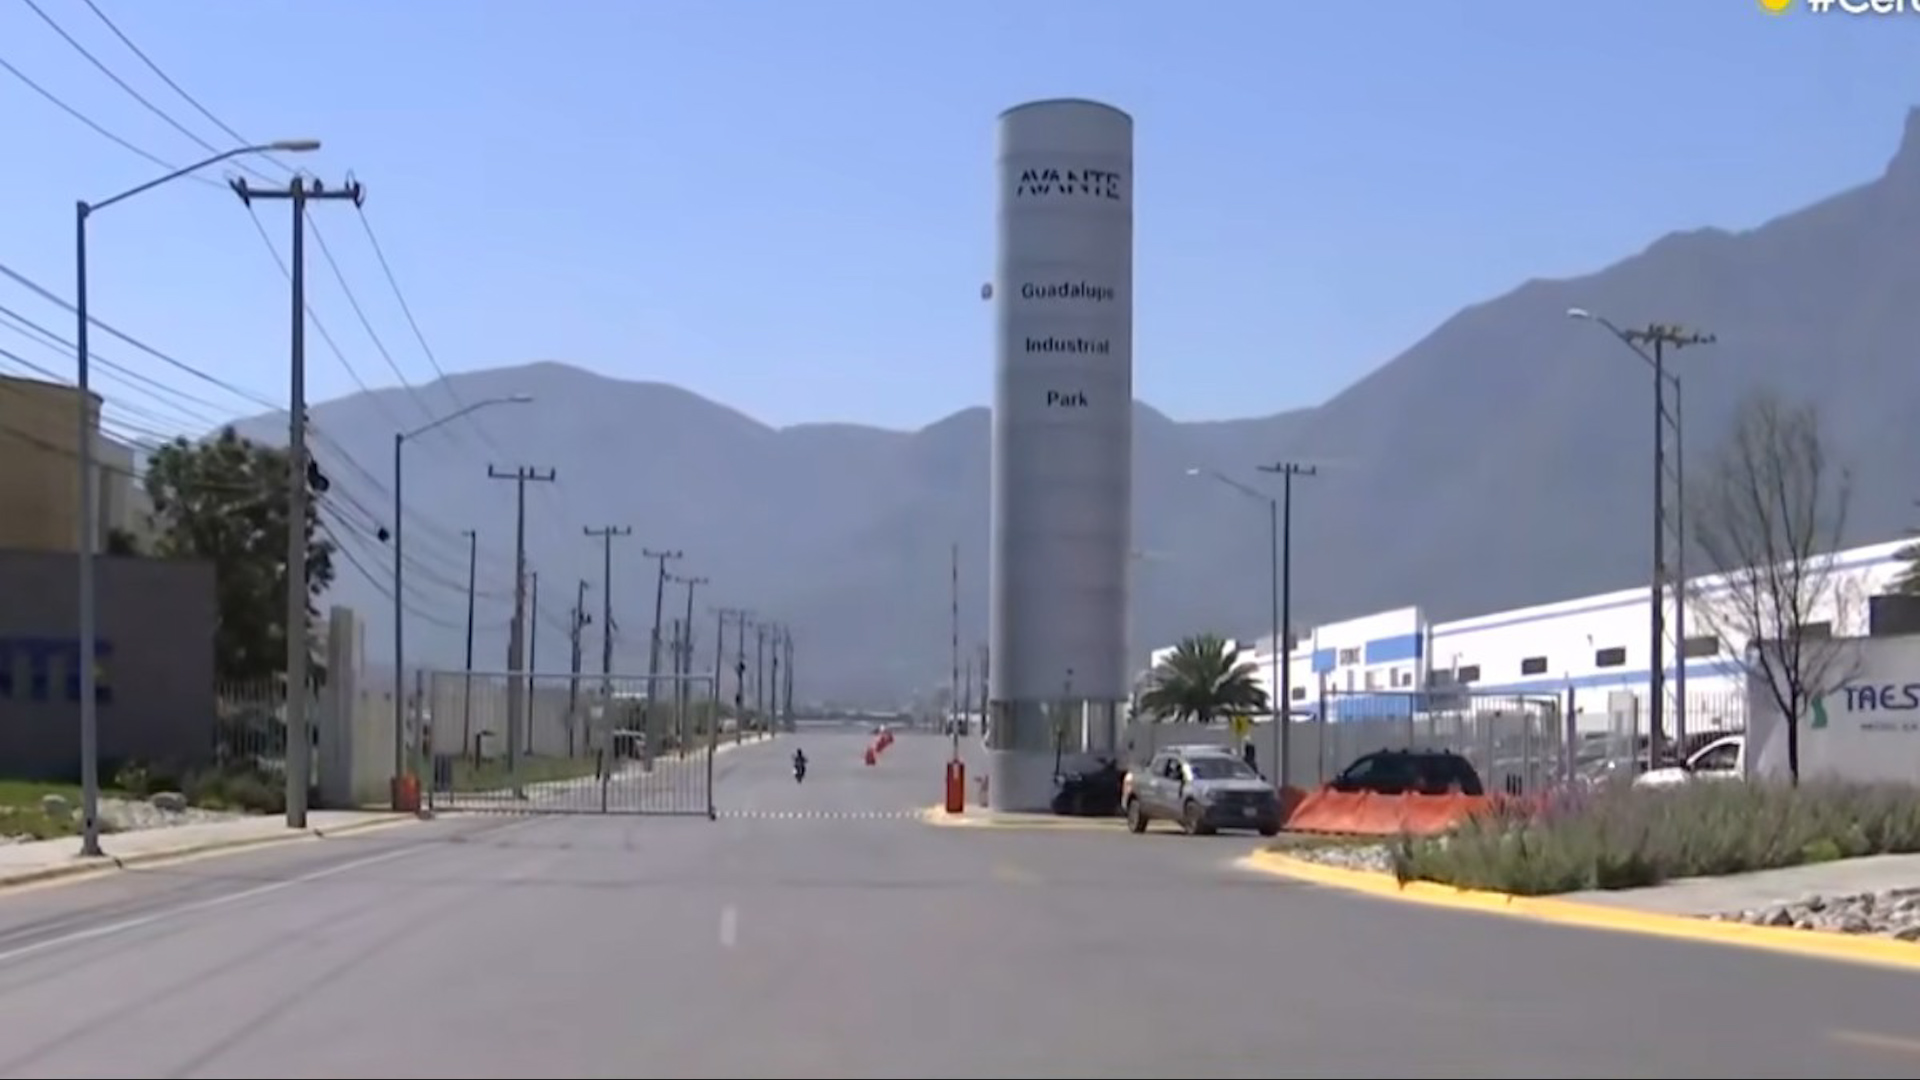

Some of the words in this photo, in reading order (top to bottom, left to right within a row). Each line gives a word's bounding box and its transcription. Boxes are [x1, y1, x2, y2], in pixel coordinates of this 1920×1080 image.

[1017, 168, 1121, 200] AVANTE
[1021, 281, 1115, 302] Guadalupe
[1025, 336, 1110, 355] Industrial
[1046, 389, 1088, 408] Park
